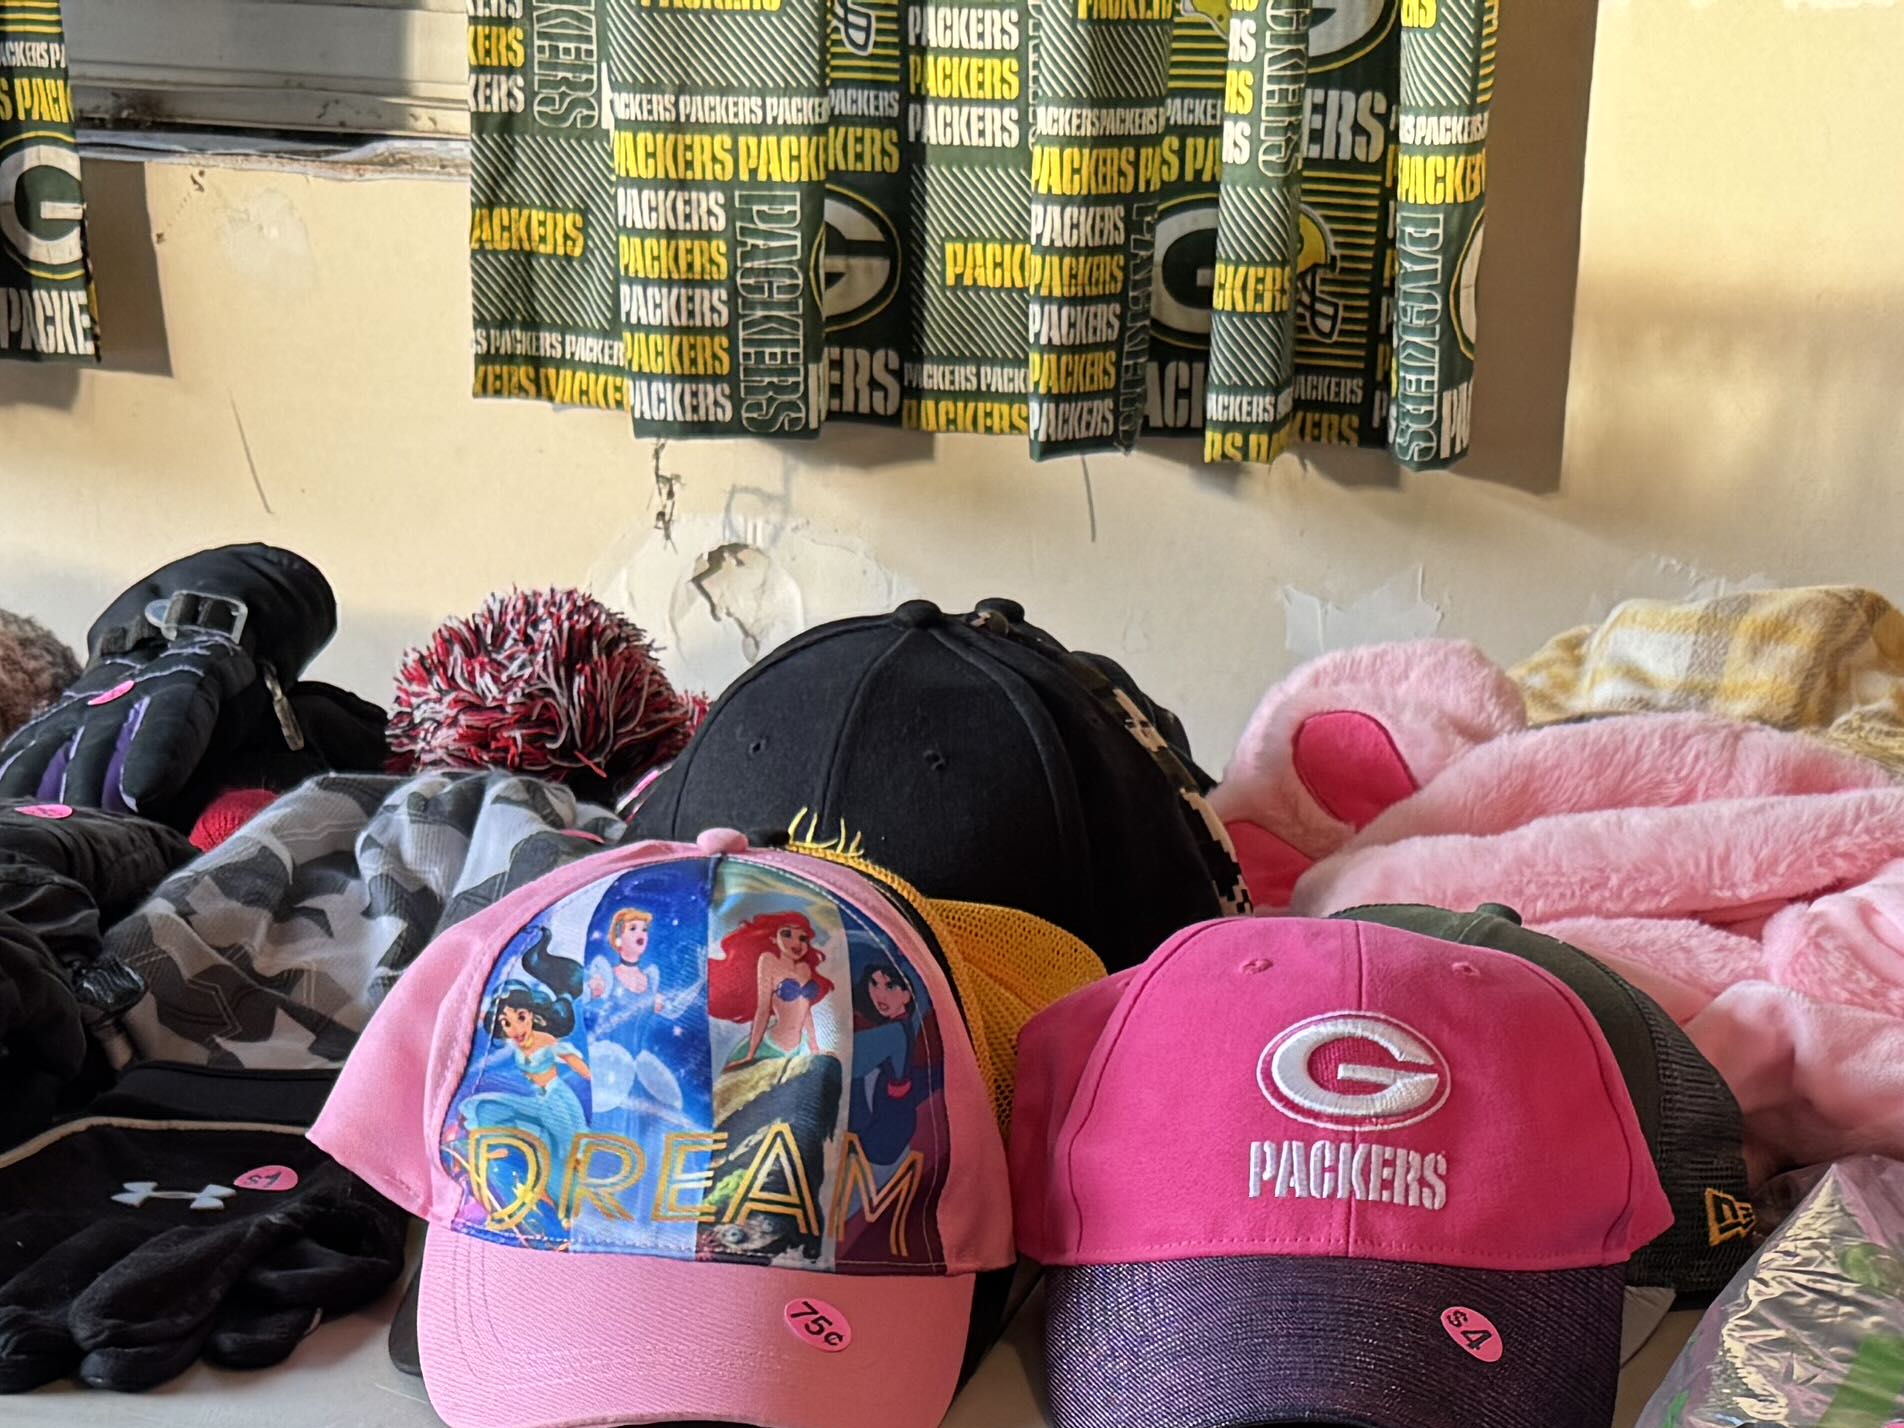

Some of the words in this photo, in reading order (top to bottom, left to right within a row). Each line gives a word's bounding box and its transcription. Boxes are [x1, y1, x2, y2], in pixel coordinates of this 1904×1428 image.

[907, 5, 1020, 51] PACKERS
[907, 54, 1020, 102] PACKERS
[679, 95, 764, 125] PACKERS
[907, 102, 1020, 150] PACKERS
[470, 207, 585, 258] ACKERS
[617, 188, 727, 232] PACKERS
[1030, 205, 1125, 249] PACKERS
[619, 235, 729, 282] PACKERS
[1030, 252, 1125, 297] PACKERS
[620, 284, 730, 329] PACKERS
[734, 190, 806, 433] PACKERS
[1029, 301, 1122, 346] PACKERS
[488, 331, 562, 358] PACKERS
[622, 332, 731, 376] PACKERS
[1028, 350, 1117, 395] PACKERS
[1028, 397, 1115, 443] PACKERS
[467, 1121, 926, 1258] DREAM
[1248, 1139, 1448, 1212] PACKERS
[789, 1299, 846, 1348] 75¢
[1446, 1309, 1493, 1351] $4
